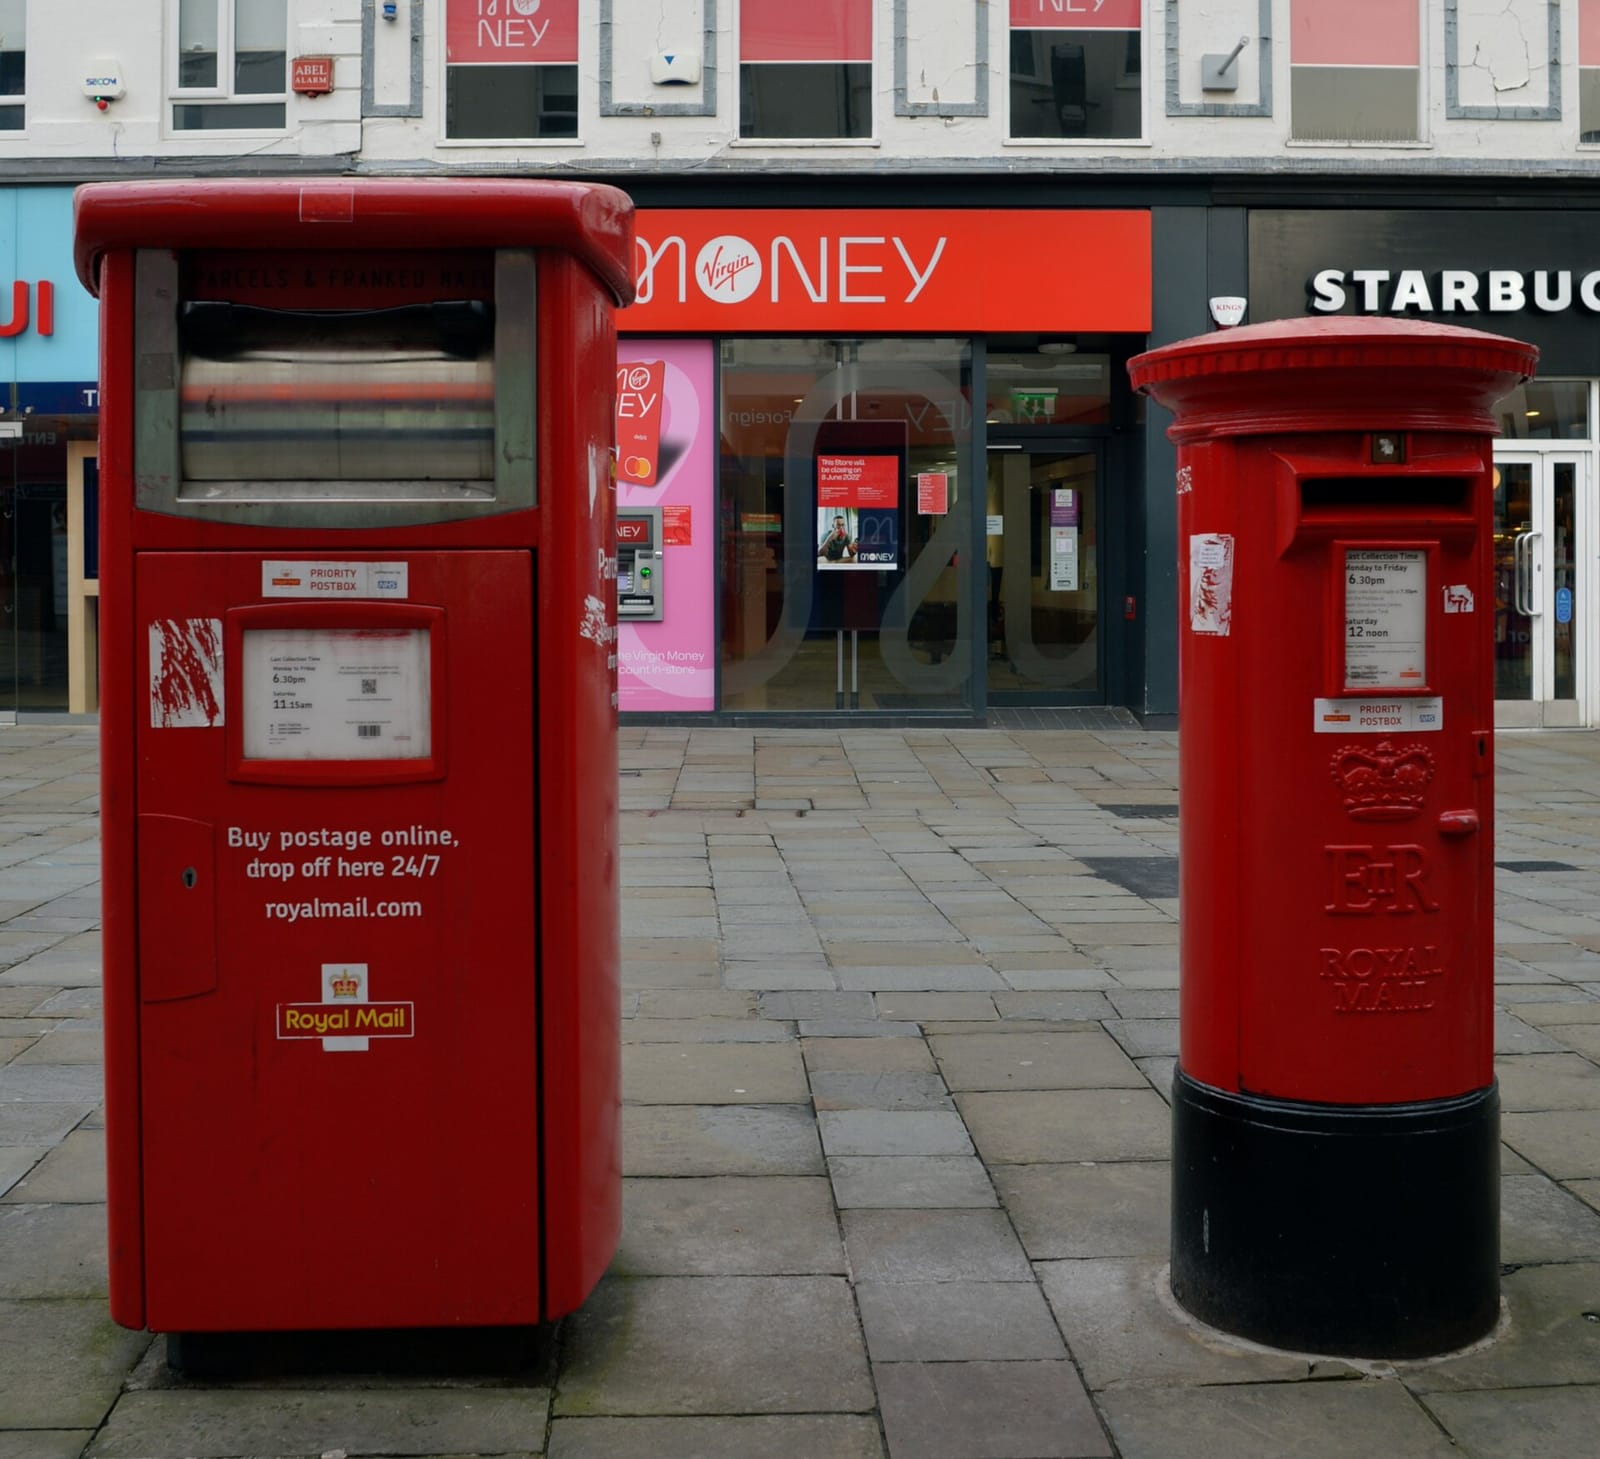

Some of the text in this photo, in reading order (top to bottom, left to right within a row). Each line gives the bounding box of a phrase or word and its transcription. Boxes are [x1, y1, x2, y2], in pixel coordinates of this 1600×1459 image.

[478, 19, 550, 47] NEY
[295, 65, 328, 76] ABEL
[295, 76, 328, 84] ALARM
[702, 245, 755, 292] Virgin
[1215, 303, 1243, 312] KINGS
[618, 392, 656, 418] EY
[860, 553, 894, 561] MONEY
[1348, 552, 1418, 560] ast Collection Time
[310, 568, 357, 578] PRIORITY
[1384, 564, 1408, 573] Friday
[1348, 574, 1385, 586] 6.30pm
[310, 581, 357, 591] POSTBOX
[1348, 626, 1364, 637] 12
[633, 651, 665, 664] Virgin
[666, 650, 705, 662] Money
[618, 665, 650, 674] count
[272, 673, 306, 684] 6.30pm
[273, 699, 313, 709] 11.15am
[1359, 704, 1402, 714] PRIORITY
[1359, 716, 1402, 726] POSTBOX
[227, 825, 460, 851] Buy postage online,
[246, 854, 441, 882] drop off here 24/7
[265, 896, 422, 923] royalmail.com
[1319, 945, 1445, 980] ROYAL
[1333, 980, 1435, 1013] MAIL
[286, 1008, 405, 1033] Royal Mail
